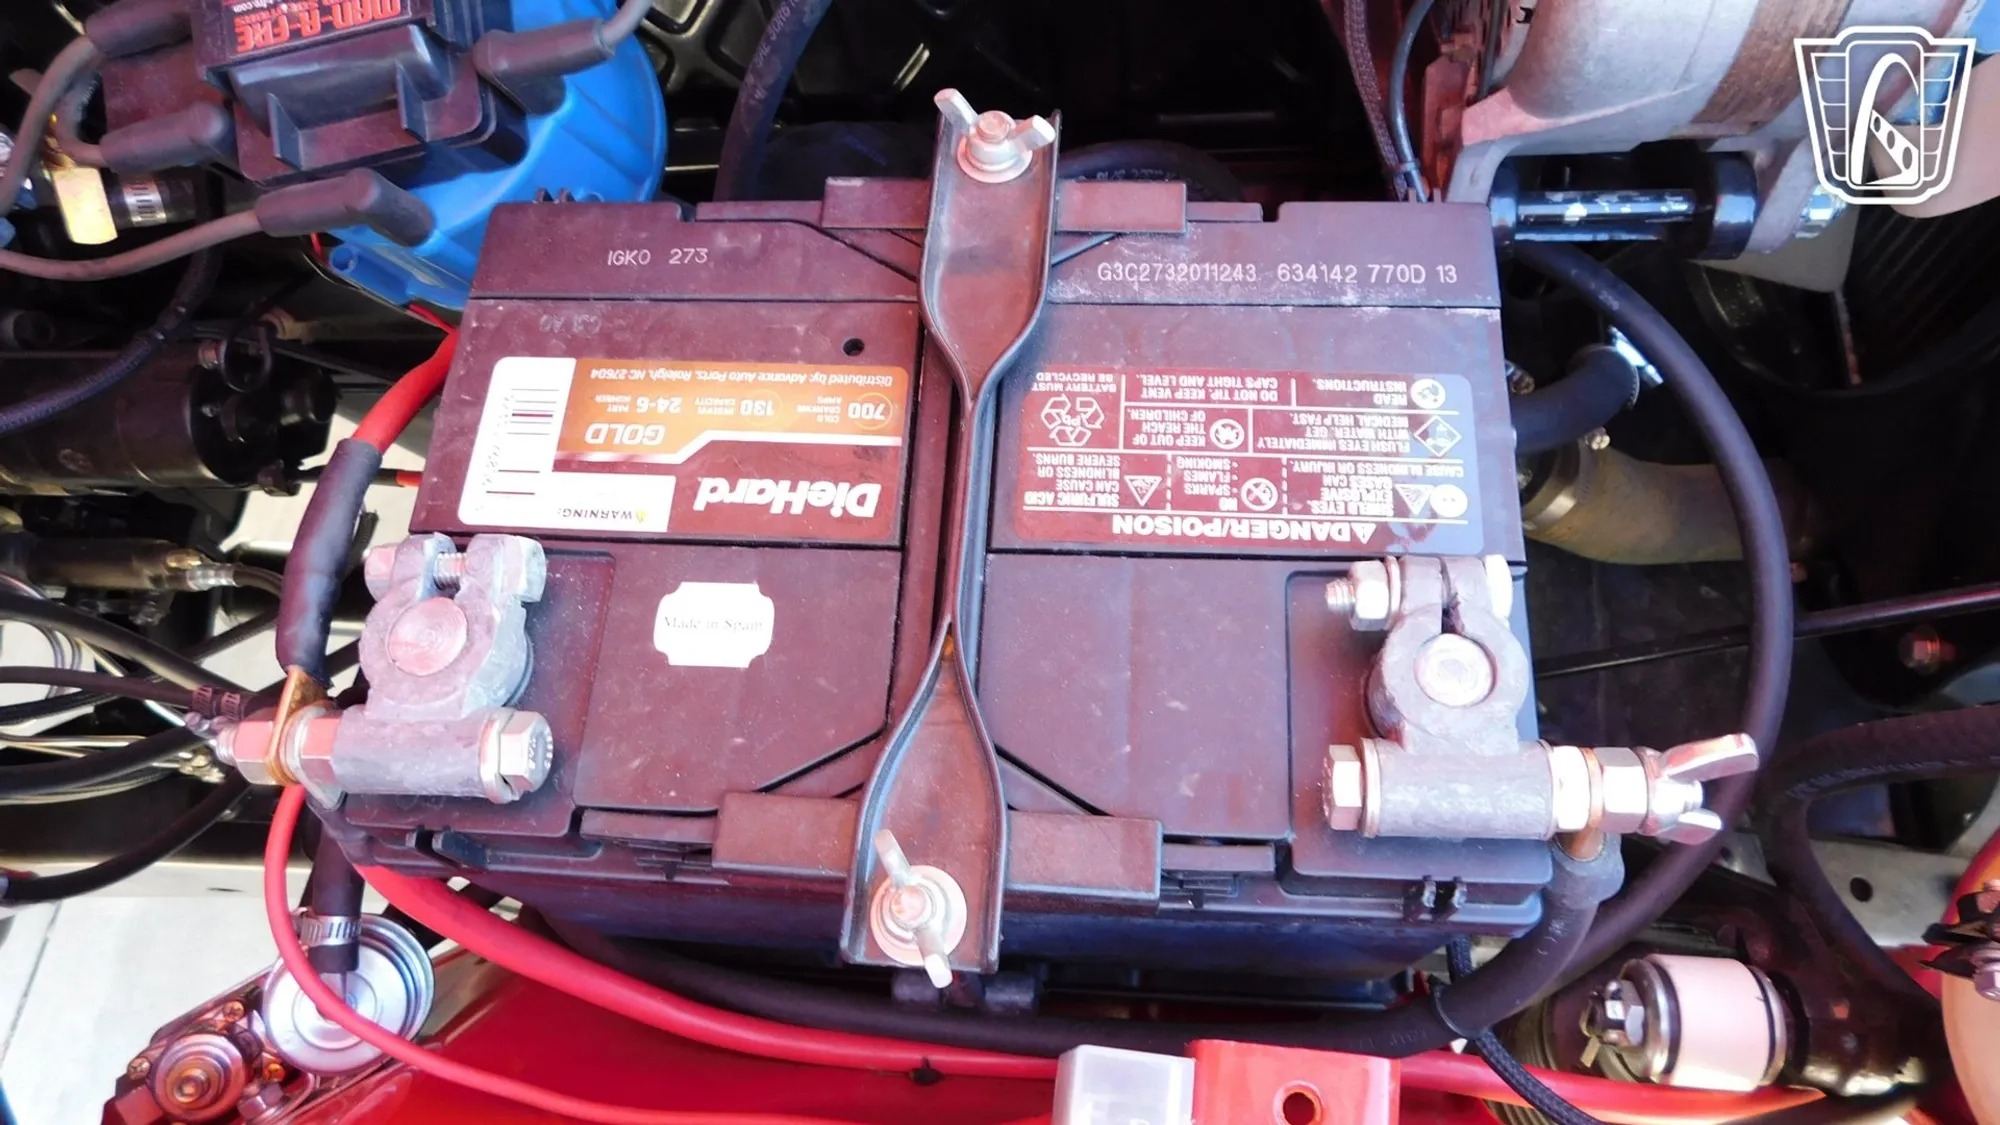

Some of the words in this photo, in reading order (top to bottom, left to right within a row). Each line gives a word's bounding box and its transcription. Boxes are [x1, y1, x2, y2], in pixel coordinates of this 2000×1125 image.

[668, 247, 709, 265] 273
[1277, 263, 1357, 283] 634142
[1436, 264, 1458, 284] 13
[591, 369, 627, 379] 27604
[628, 370, 646, 380] NC
[730, 372, 757, 383] Auto
[758, 372, 807, 384] Advance
[810, 372, 826, 385] by:
[1036, 372, 1095, 382] RECYCLED
[1097, 373, 1113, 382] BE
[1136, 374, 1176, 386] LEVEL.
[828, 374, 892, 387] Distributed
[1032, 382, 1063, 391] MUST
[1179, 375, 1204, 387] AND
[1206, 376, 1242, 388] TIGHT
[1246, 376, 1278, 389] CAPS
[1313, 378, 1406, 392] INSTRUCTIONS.
[1065, 382, 1117, 393] BATTERY
[1141, 387, 1172, 399] VENT
[1175, 388, 1205, 400] KEEP
[1209, 388, 1230, 400] TIP.
[1233, 389, 1257, 401] NOT
[1260, 390, 1278, 401] DO
[1374, 393, 1407, 405] READ
[636, 396, 682, 413] 24-6
[740, 399, 774, 416] 130
[848, 403, 886, 419] 700
[1127, 408, 1188, 421] CHILDREN.
[1190, 410, 1206, 421] OF
[1290, 412, 1321, 424] FAST.
[1323, 414, 1354, 426] HELP
[1357, 414, 1408, 428] MEDICAL
[1142, 421, 1184, 433] REACH
[1186, 423, 1206, 434] THE
[1305, 426, 1328, 438] GET
[585, 423, 665, 445] GOLD
[1132, 433, 1150, 445] OF
[1153, 434, 1174, 446] OUT
[1378, 428, 1409, 441] WITH
[1176, 435, 1206, 446] KEEP
[1257, 436, 1336, 451] IMMEDIATELY
[1338, 439, 1369, 452] EYES
[1371, 440, 1410, 453] FLUSH
[1033, 453, 1074, 465] BURNS.
[1077, 454, 1120, 467] SEVERE
[1176, 456, 1231, 469] SMOKING
[1037, 466, 1054, 477] OR
[1056, 466, 1120, 479] BLINDNESS
[1290, 460, 1335, 473] INJURY.
[1338, 462, 1355, 474] OR
[1357, 462, 1422, 476] BLINDNESS
[1184, 470, 1230, 483] FLAMES
[1323, 474, 1347, 487] CAN
[1056, 479, 1094, 491] CAUSE
[1095, 480, 1119, 492] CAN
[1184, 483, 1230, 495] SPARKS
[693, 477, 881, 518] DieHard
[1024, 491, 1055, 505] ACID
[1056, 492, 1119, 507] SULFURIC
[1320, 487, 1392, 502] EXPLOSIVE
[1219, 497, 1238, 510] NO
[557, 508, 632, 520] WARNING:
[1112, 514, 1351, 542] DANGER/POISON
[665, 616, 700, 629] Made
